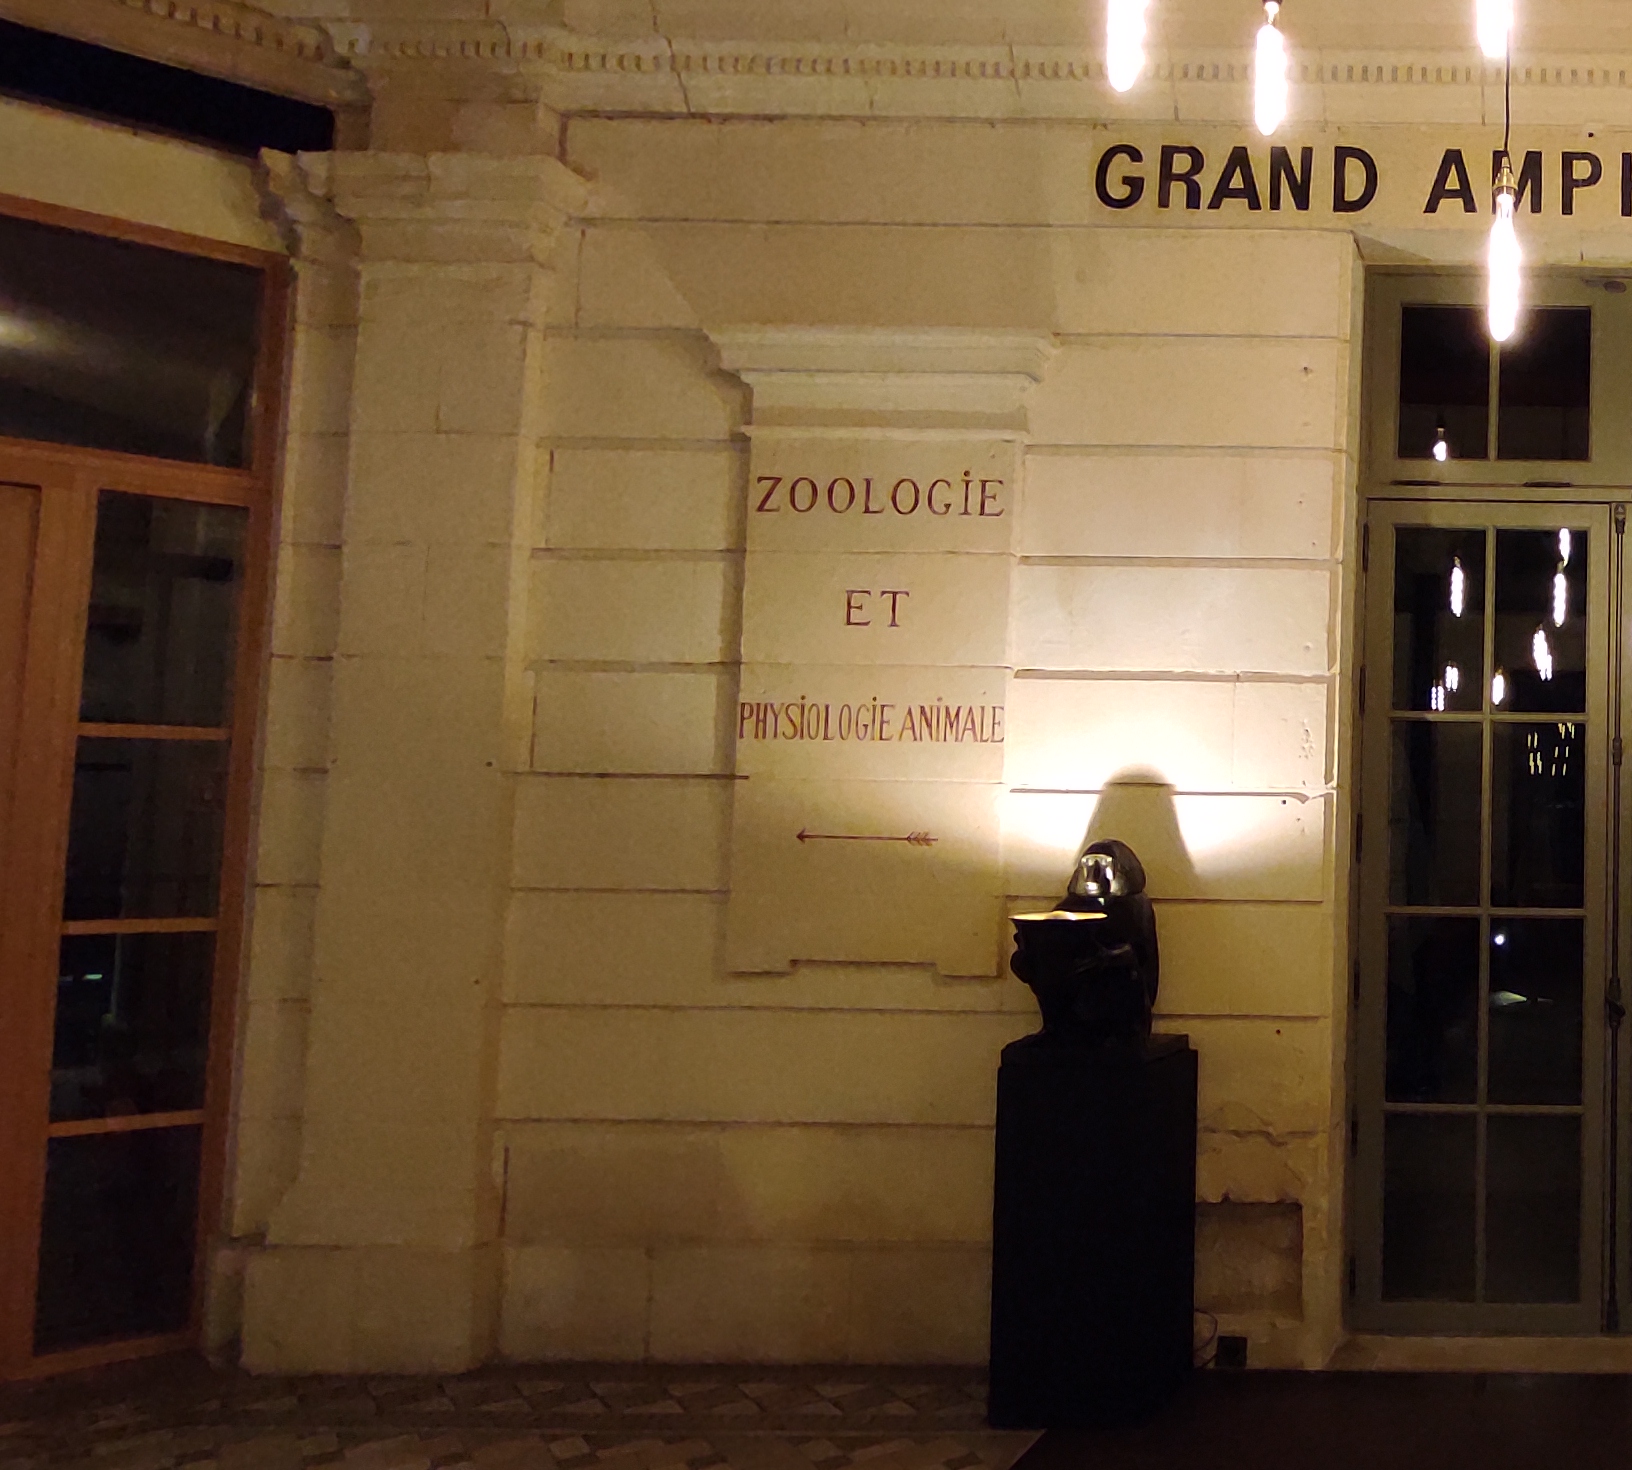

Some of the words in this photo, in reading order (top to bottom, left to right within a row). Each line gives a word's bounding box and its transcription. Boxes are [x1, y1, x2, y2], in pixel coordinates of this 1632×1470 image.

[1094, 143, 1379, 213] GRAND
[756, 470, 1005, 517] ZOOLOGIE
[844, 590, 910, 627] ET
[898, 697, 1005, 743] ANIMALE
